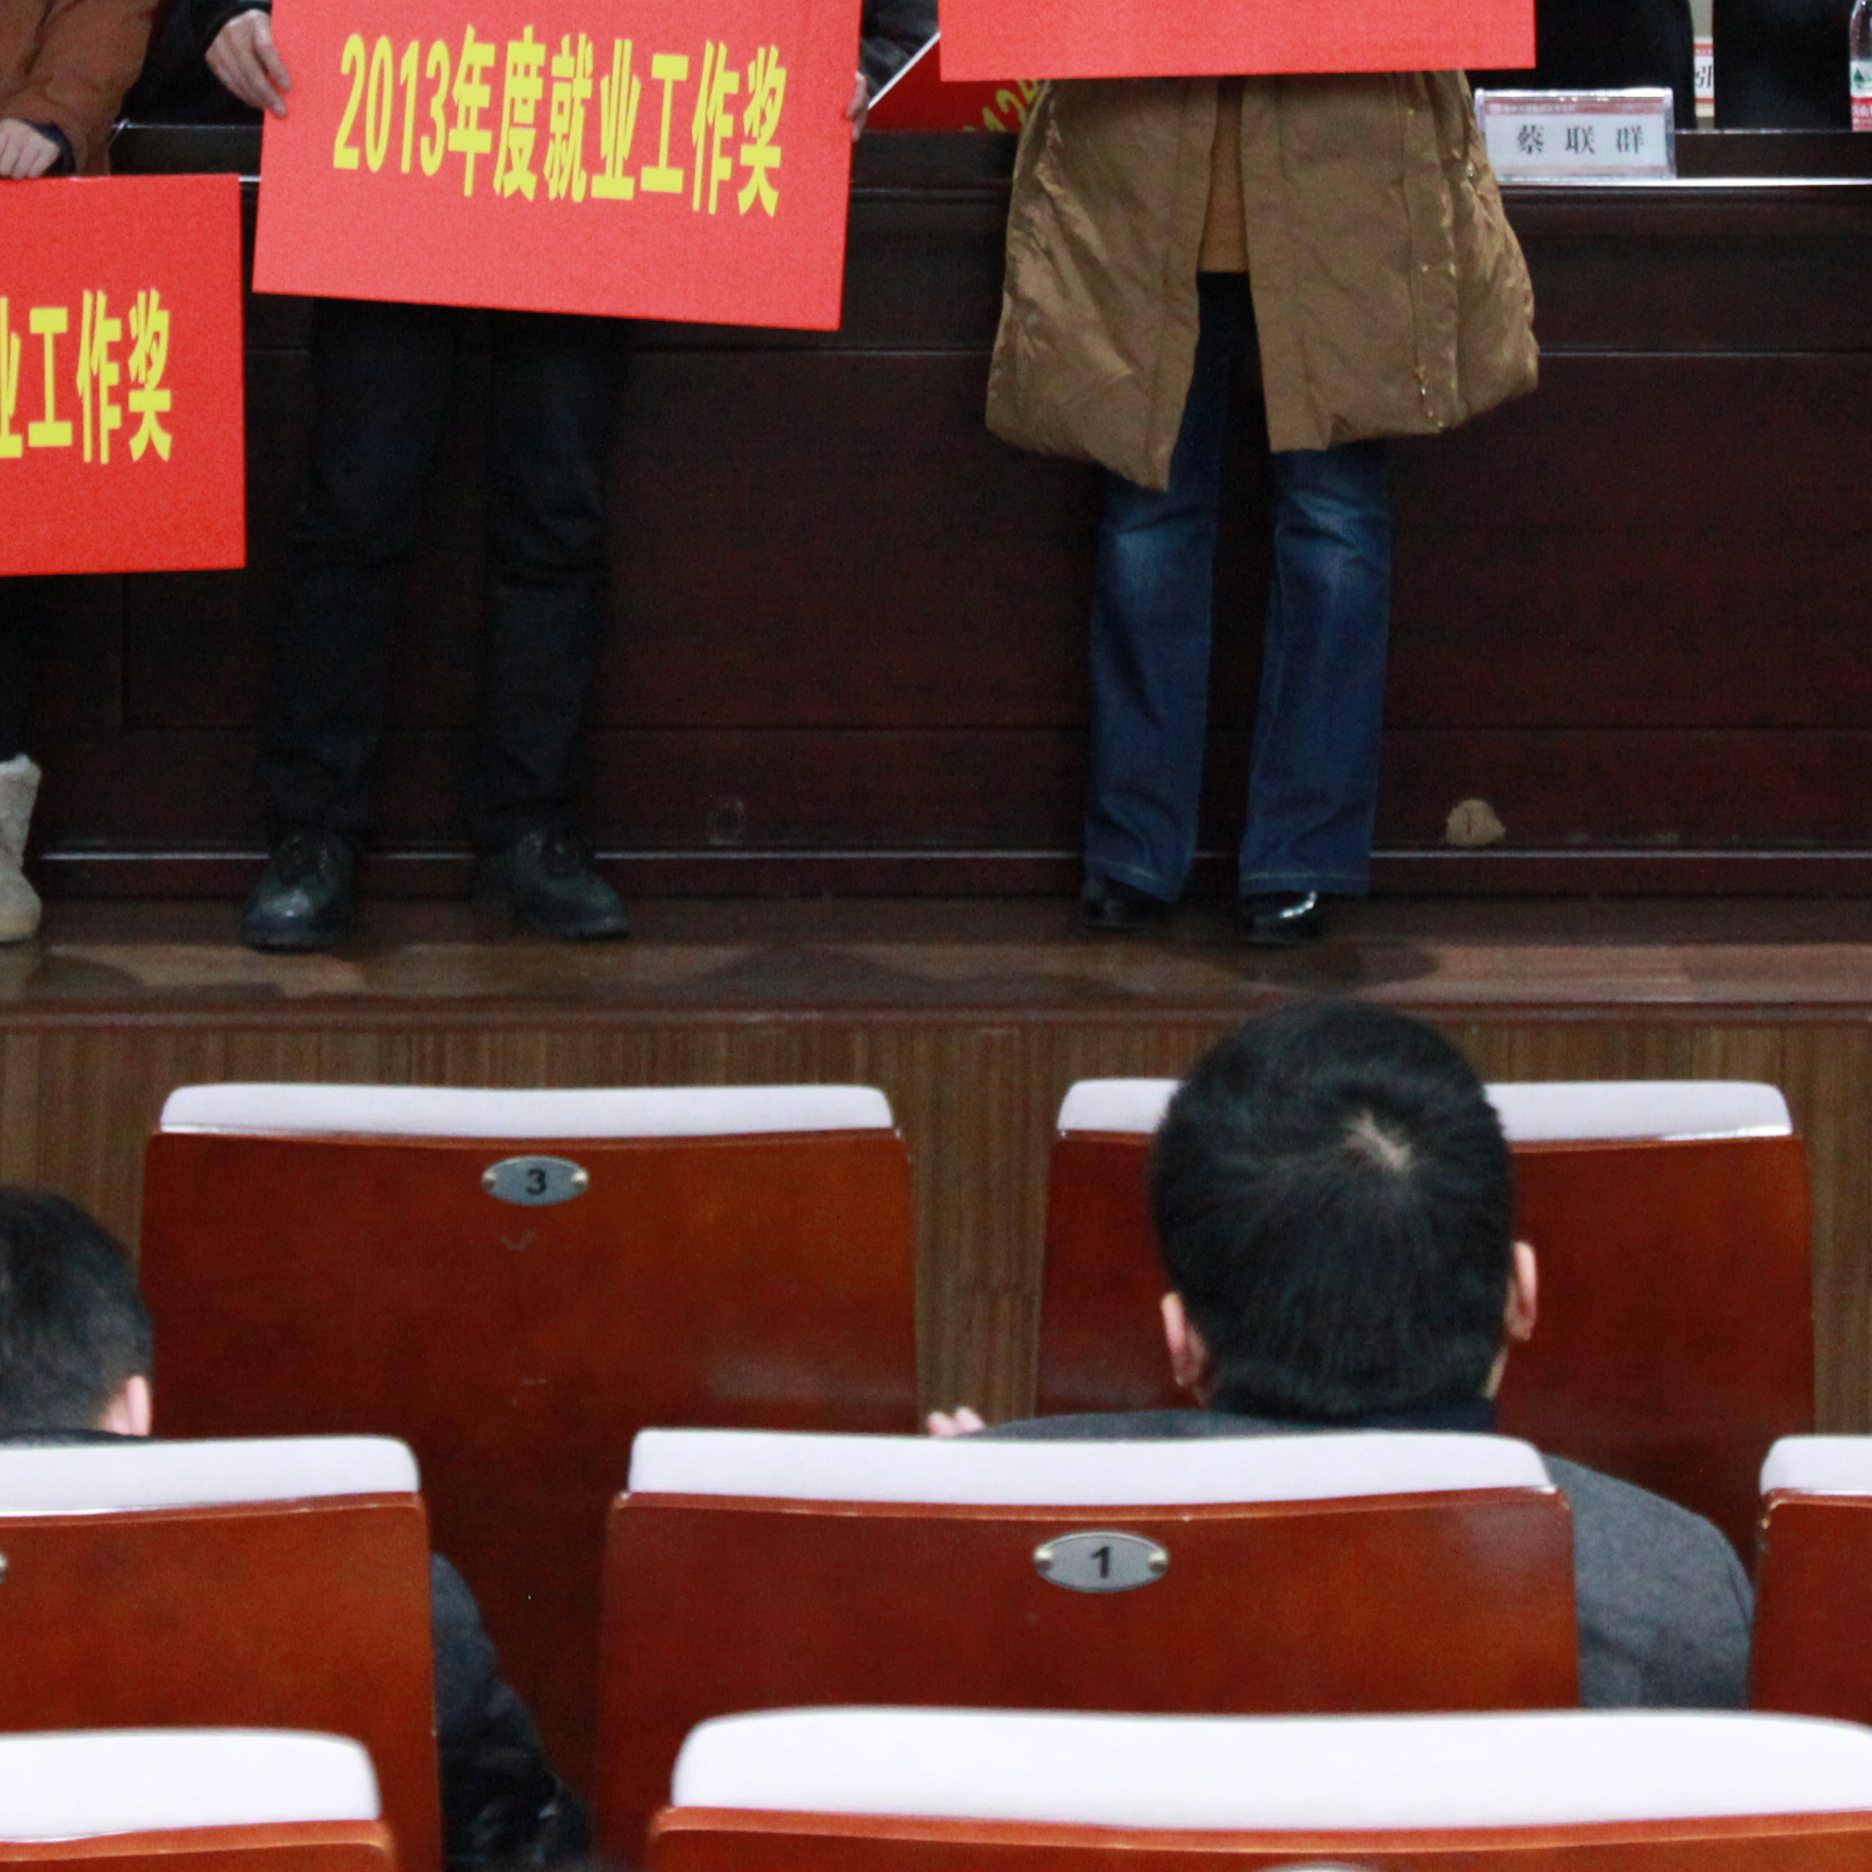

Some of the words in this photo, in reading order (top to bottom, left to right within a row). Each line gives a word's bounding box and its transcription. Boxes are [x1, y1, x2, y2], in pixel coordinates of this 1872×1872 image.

[333, 24, 787, 217] 2013年度就业工作奖
[525, 1167, 548, 1197] 3
[1090, 1546, 1110, 1579] 1
